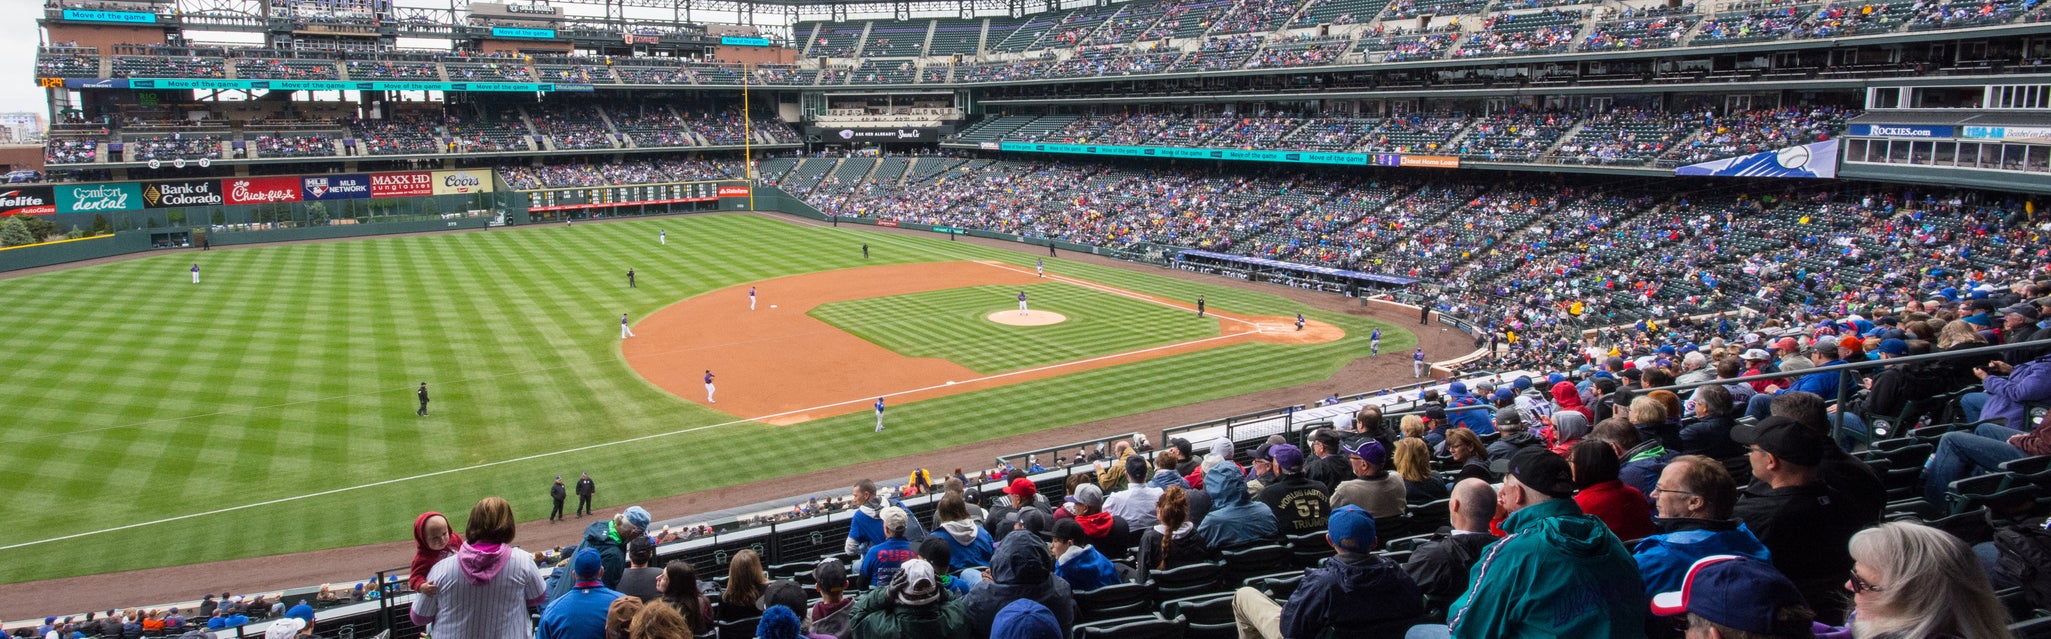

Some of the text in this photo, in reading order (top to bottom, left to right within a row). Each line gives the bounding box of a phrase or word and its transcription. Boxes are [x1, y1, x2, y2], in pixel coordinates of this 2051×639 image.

[1870, 125, 1931, 136] ROCKIES.com
[307, 178, 327, 187] MLB
[372, 174, 430, 185] MAXX HD
[444, 175, 479, 187] Coors
[73, 185, 121, 199] Comfort
[161, 182, 209, 194] Bank of
[232, 182, 295, 202] Chick-fil-A
[329, 184, 367, 193] NETWORK
[72, 193, 128, 211] dental
[162, 192, 221, 205] Colorado
[1294, 498, 1320, 518] 57
